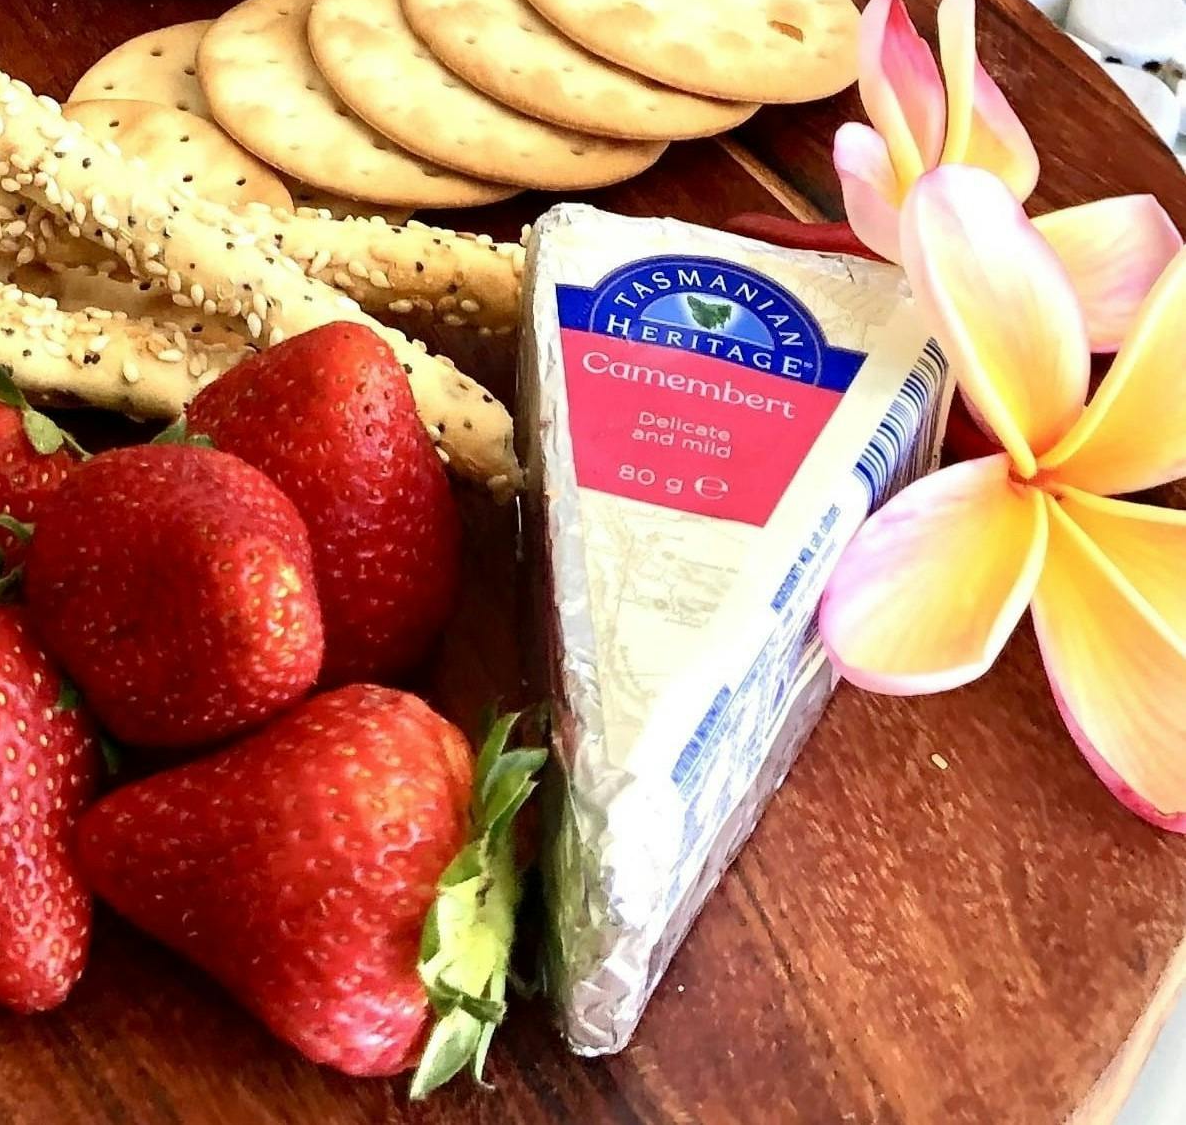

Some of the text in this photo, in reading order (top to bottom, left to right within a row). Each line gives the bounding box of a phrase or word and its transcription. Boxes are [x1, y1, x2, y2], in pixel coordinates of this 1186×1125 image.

[614, 269, 804, 348] TASMANIAN
[607, 315, 803, 379] HERITAGE
[582, 351, 797, 420] Camembert
[631, 427, 732, 460] and mild
[638, 411, 732, 442] Delicate
[618, 464, 656, 487] 80
